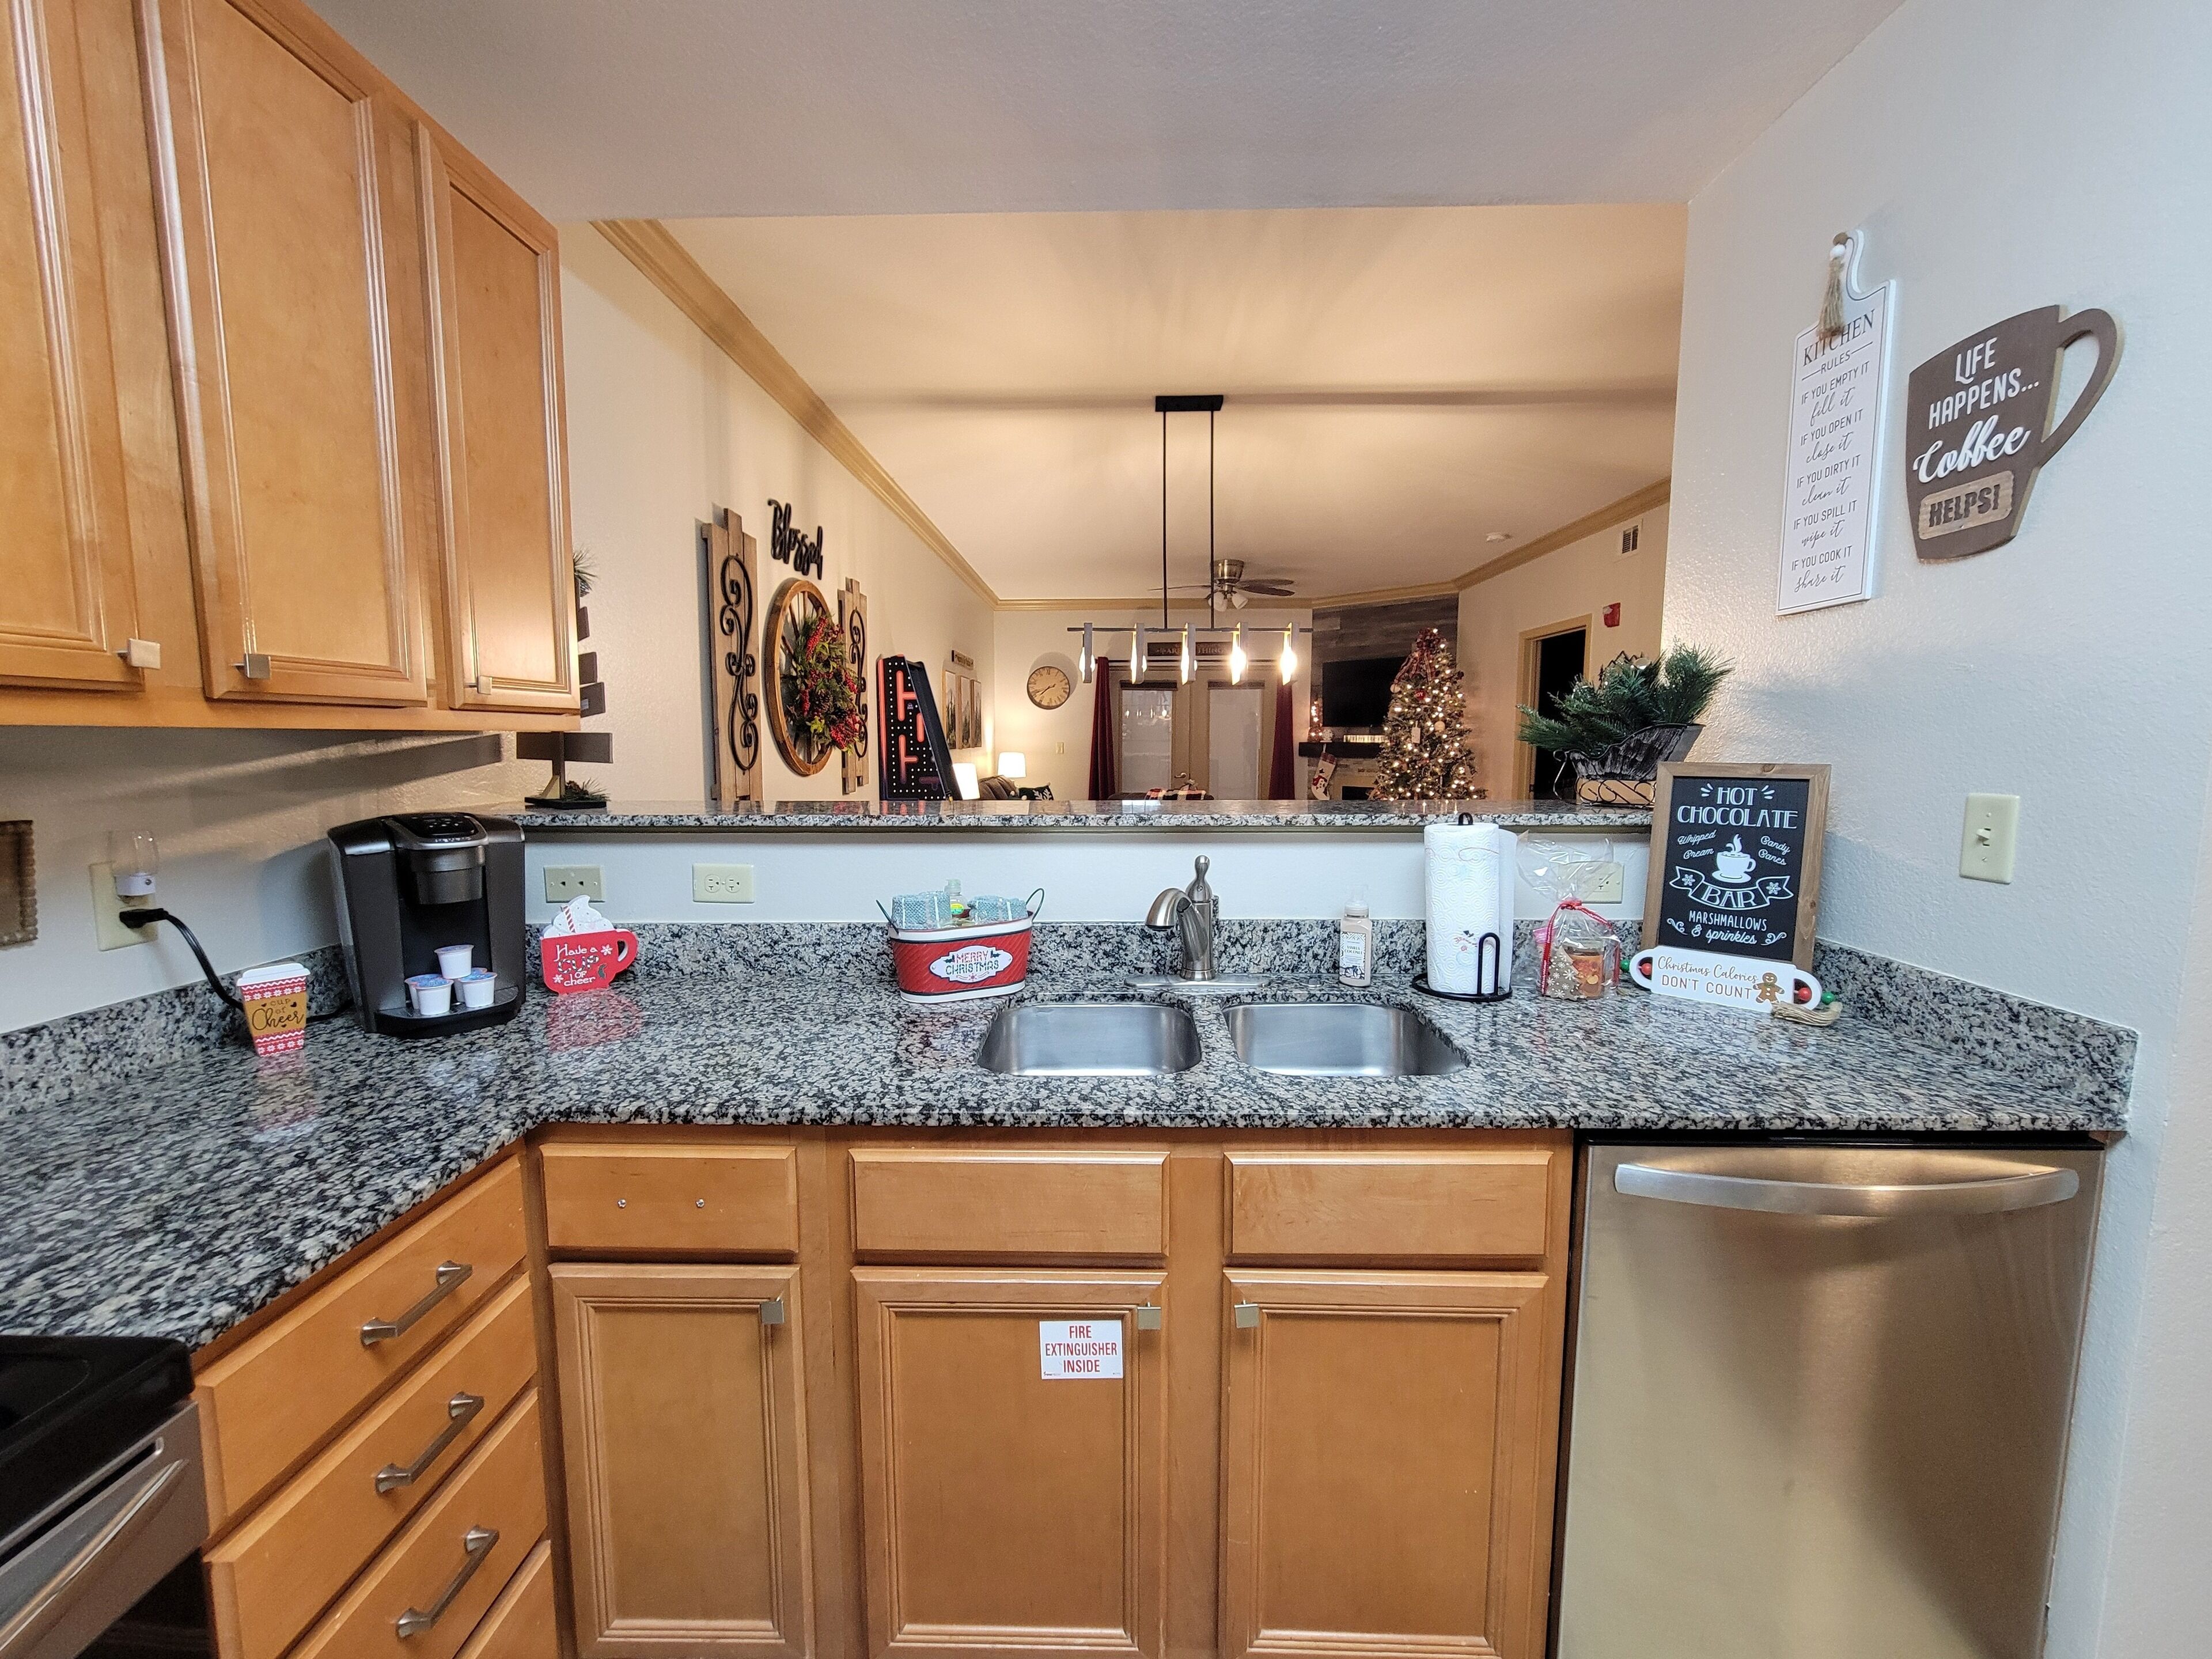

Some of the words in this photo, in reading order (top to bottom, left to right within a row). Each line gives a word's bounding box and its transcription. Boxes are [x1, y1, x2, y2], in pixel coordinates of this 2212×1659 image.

[1804, 309, 1874, 366] KITCHEN
[1821, 350, 1850, 374] RULES
[1955, 337, 1998, 384] LIFE
[1801, 392, 1809, 405] IF
[1812, 382, 1827, 399] YOU
[1830, 366, 1858, 391] EMPTY
[1861, 361, 1869, 375] IT
[1810, 392, 1835, 426] fill
[1840, 387, 1855, 407] it
[1801, 433, 1808, 446] IF
[1811, 426, 1826, 441] YOU
[1829, 414, 1851, 434] OPEN
[1855, 408, 1863, 422] IT
[1806, 441, 1834, 463] close
[1839, 431, 1854, 450] it
[1912, 414, 2031, 483] Coffee
[1797, 476, 1804, 488] IF
[1807, 469, 1822, 484] YOU
[1825, 459, 1850, 478] DIRTY
[1853, 454, 1861, 467] IT
[1802, 484, 1833, 506] clean
[1836, 476, 1851, 495] it
[1794, 518, 1801, 530] IF
[1804, 513, 1819, 527] YOU
[1821, 505, 1845, 521] SPILL
[1849, 500, 1857, 513] IT
[1802, 531, 1826, 549] wipe
[1830, 519, 1845, 537] it
[1791, 560, 1799, 571] IF
[1801, 555, 1816, 569] YOU
[1819, 548, 1842, 564] COOK
[1844, 545, 1853, 558] IT
[1794, 570, 1827, 593] share
[1831, 565, 1846, 583] it
[1717, 787, 1758, 805] HOT
[1677, 806, 1798, 829] CHOCOLATE
[1677, 830, 1717, 846] Whipped
[1760, 836, 1790, 855] Candy
[1683, 849, 1714, 859] Cream
[1758, 849, 1786, 865] Canes
[1701, 886, 1756, 907] BAR
[1689, 910, 1767, 931] MARSHMALLOWS
[1691, 924, 1702, 937] &
[1706, 929, 1757, 944] sprinkles
[554, 944, 587, 961] Have
[956, 950, 988, 964] MERRY
[945, 960, 999, 975] CHRISTMAS
[1658, 956, 1710, 976] Christmas
[1714, 964, 1759, 984] Calories
[563, 974, 596, 986] cheer
[1662, 975, 1699, 990] DON'T
[1706, 982, 1752, 999] COUNT
[252, 1007, 304, 1031] Cheer
[1069, 1325, 1092, 1339] FIRE
[1045, 1342, 1118, 1356] EXTINGUISHER
[1063, 1359, 1100, 1373] INSIDE
